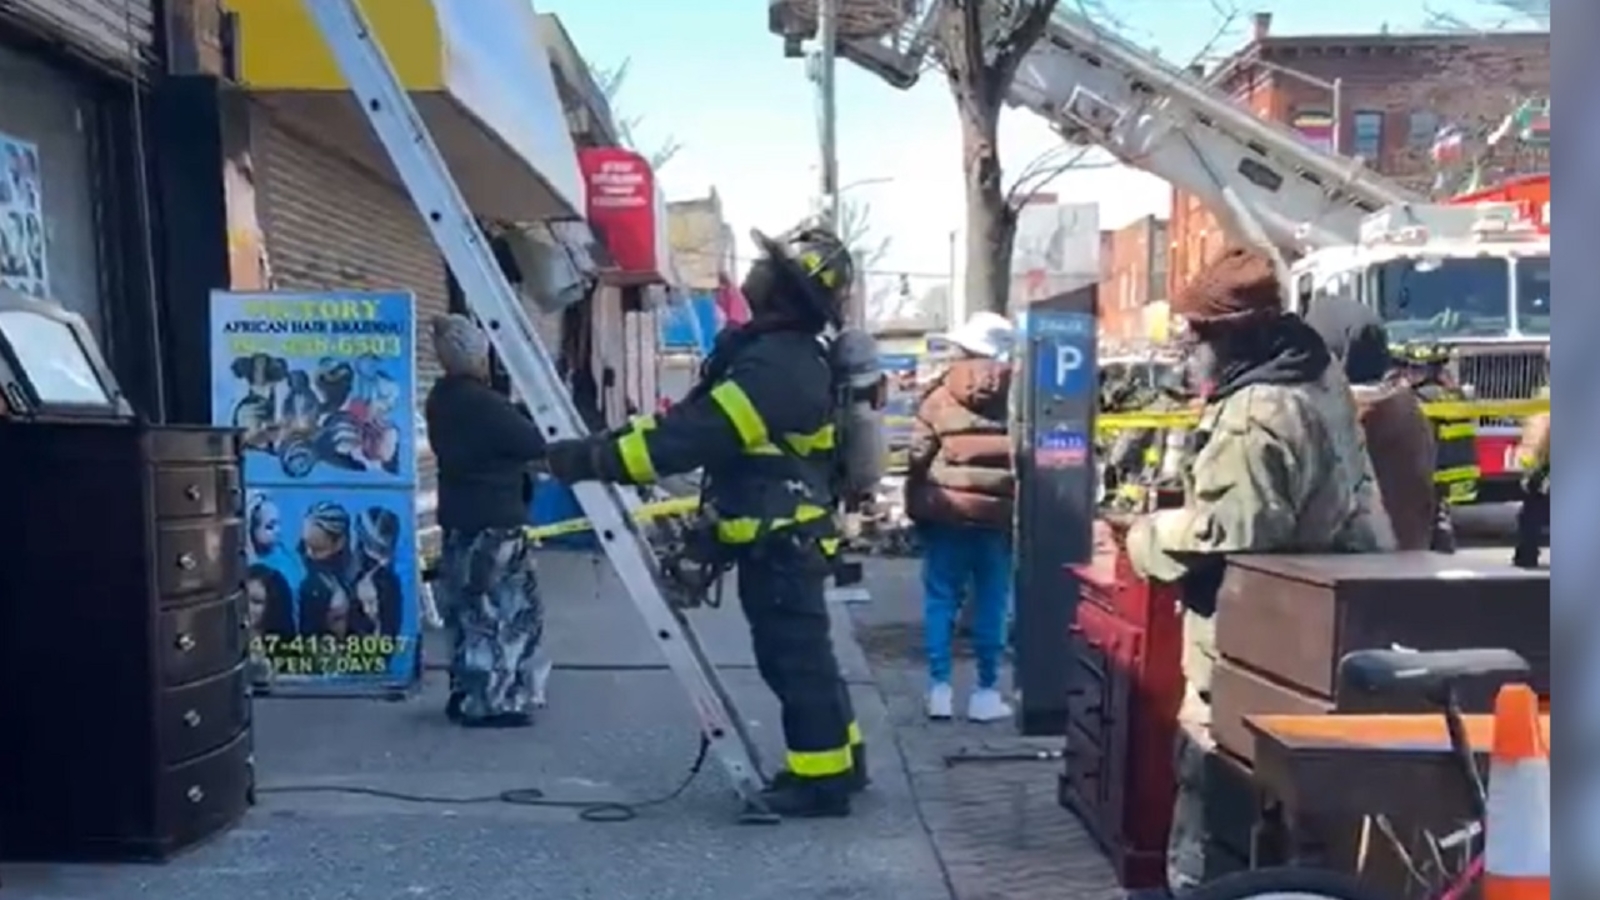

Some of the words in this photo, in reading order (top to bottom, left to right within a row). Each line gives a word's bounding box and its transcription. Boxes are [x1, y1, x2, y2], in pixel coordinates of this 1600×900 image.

[244, 299, 380, 320] CTORY
[223, 321, 288, 333] AFRICAN
[291, 321, 328, 333] HAIR
[1057, 345, 1083, 386] P
[250, 634, 408, 654] 47-413-8067
[321, 657, 334, 672] 7
[337, 656, 386, 672] DAYS
